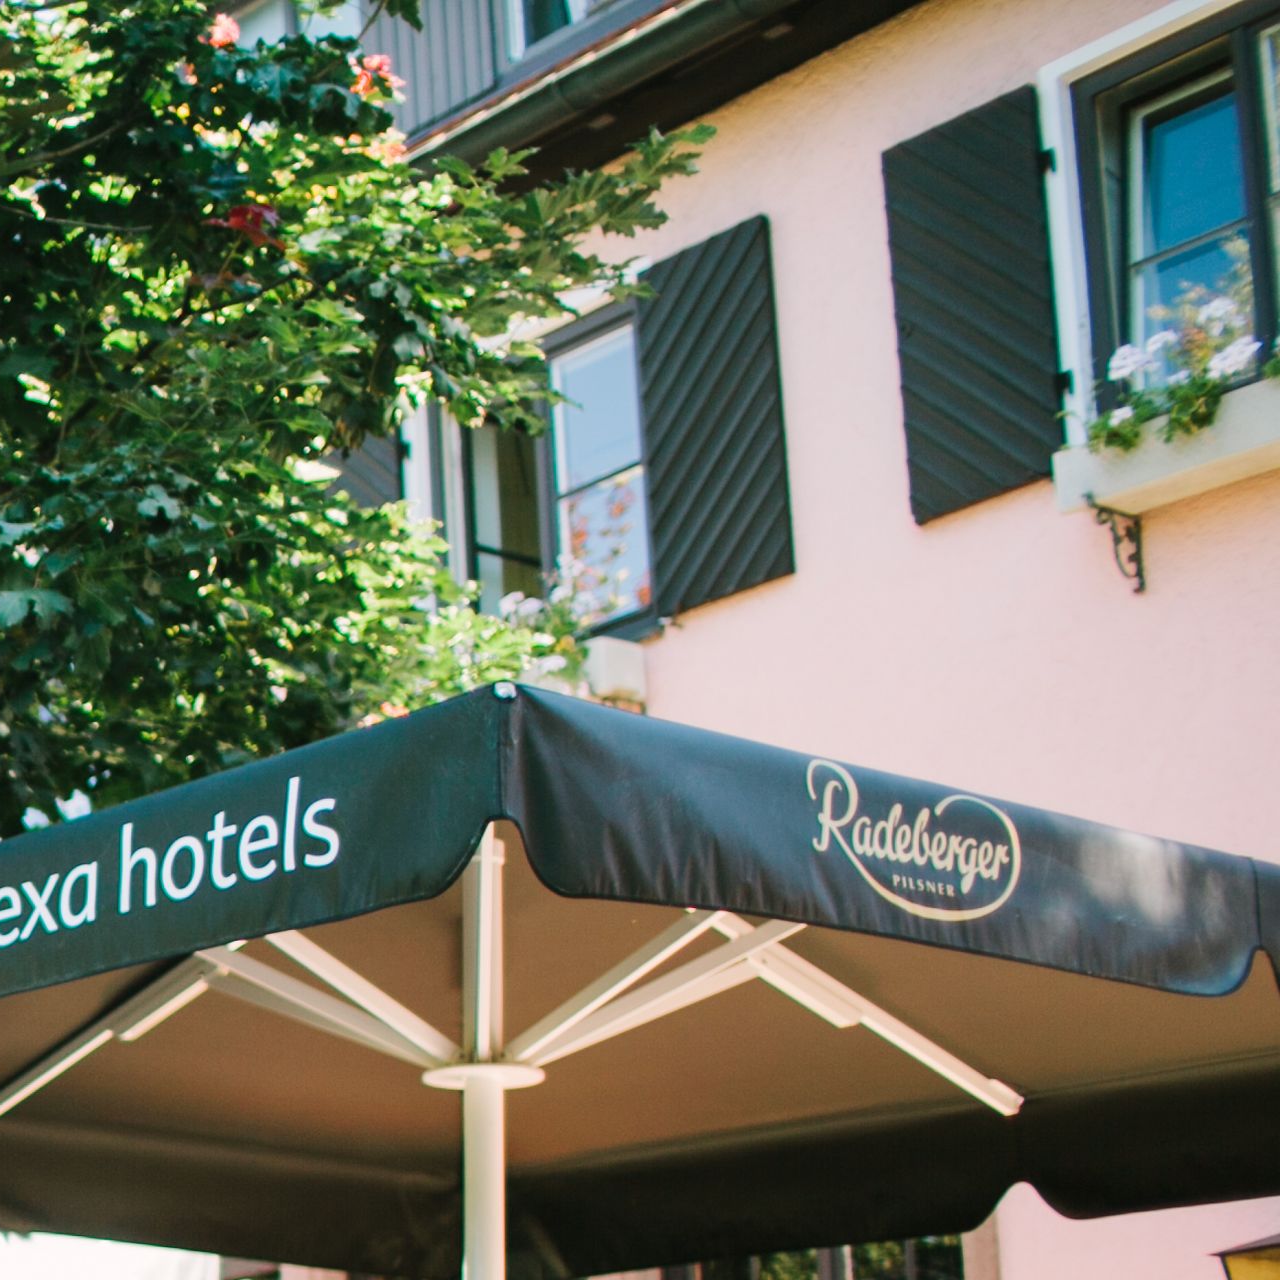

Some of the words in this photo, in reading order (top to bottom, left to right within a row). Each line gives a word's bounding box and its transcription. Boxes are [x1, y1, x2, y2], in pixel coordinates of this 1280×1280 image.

[118, 776, 340, 914] hotels
[806, 758, 1012, 895] Radeberger
[892, 873, 956, 897] PILSNER
